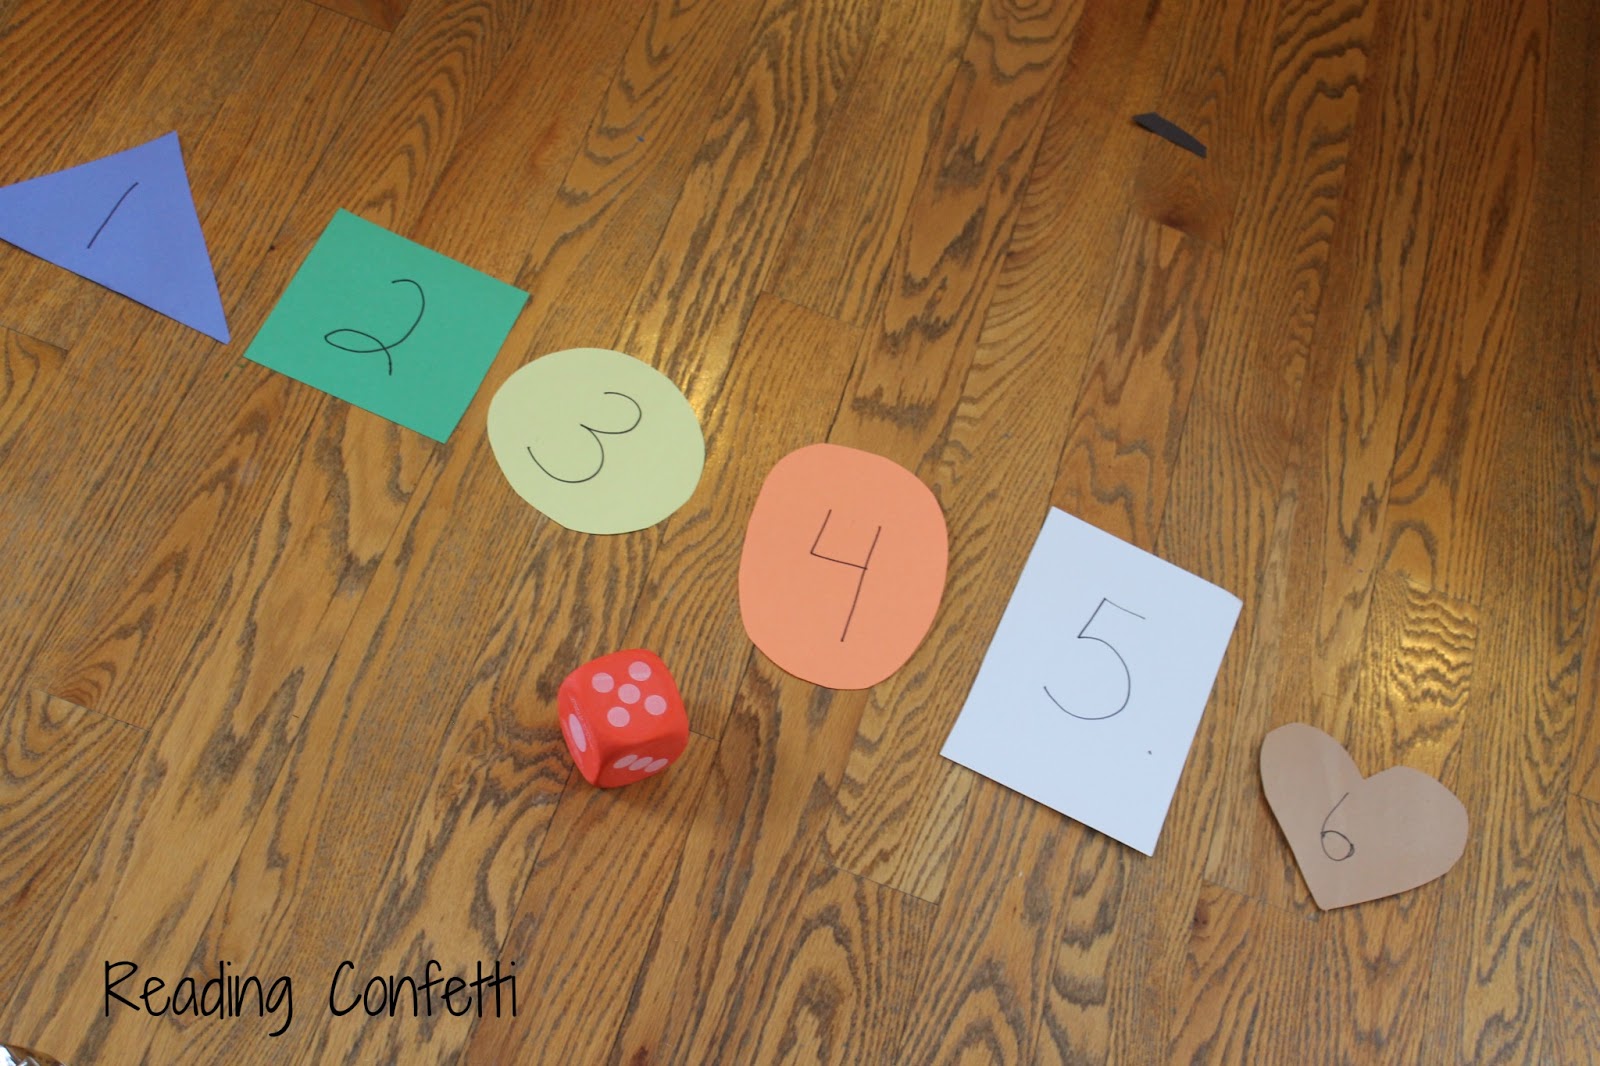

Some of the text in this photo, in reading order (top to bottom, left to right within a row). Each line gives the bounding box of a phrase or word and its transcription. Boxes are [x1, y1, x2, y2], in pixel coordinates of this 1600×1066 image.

[323, 278, 426, 376] 2
[526, 391, 643, 484] 3
[809, 509, 882, 643] 4
[1043, 597, 1146, 721] 5
[1320, 792, 1356, 862] 6
